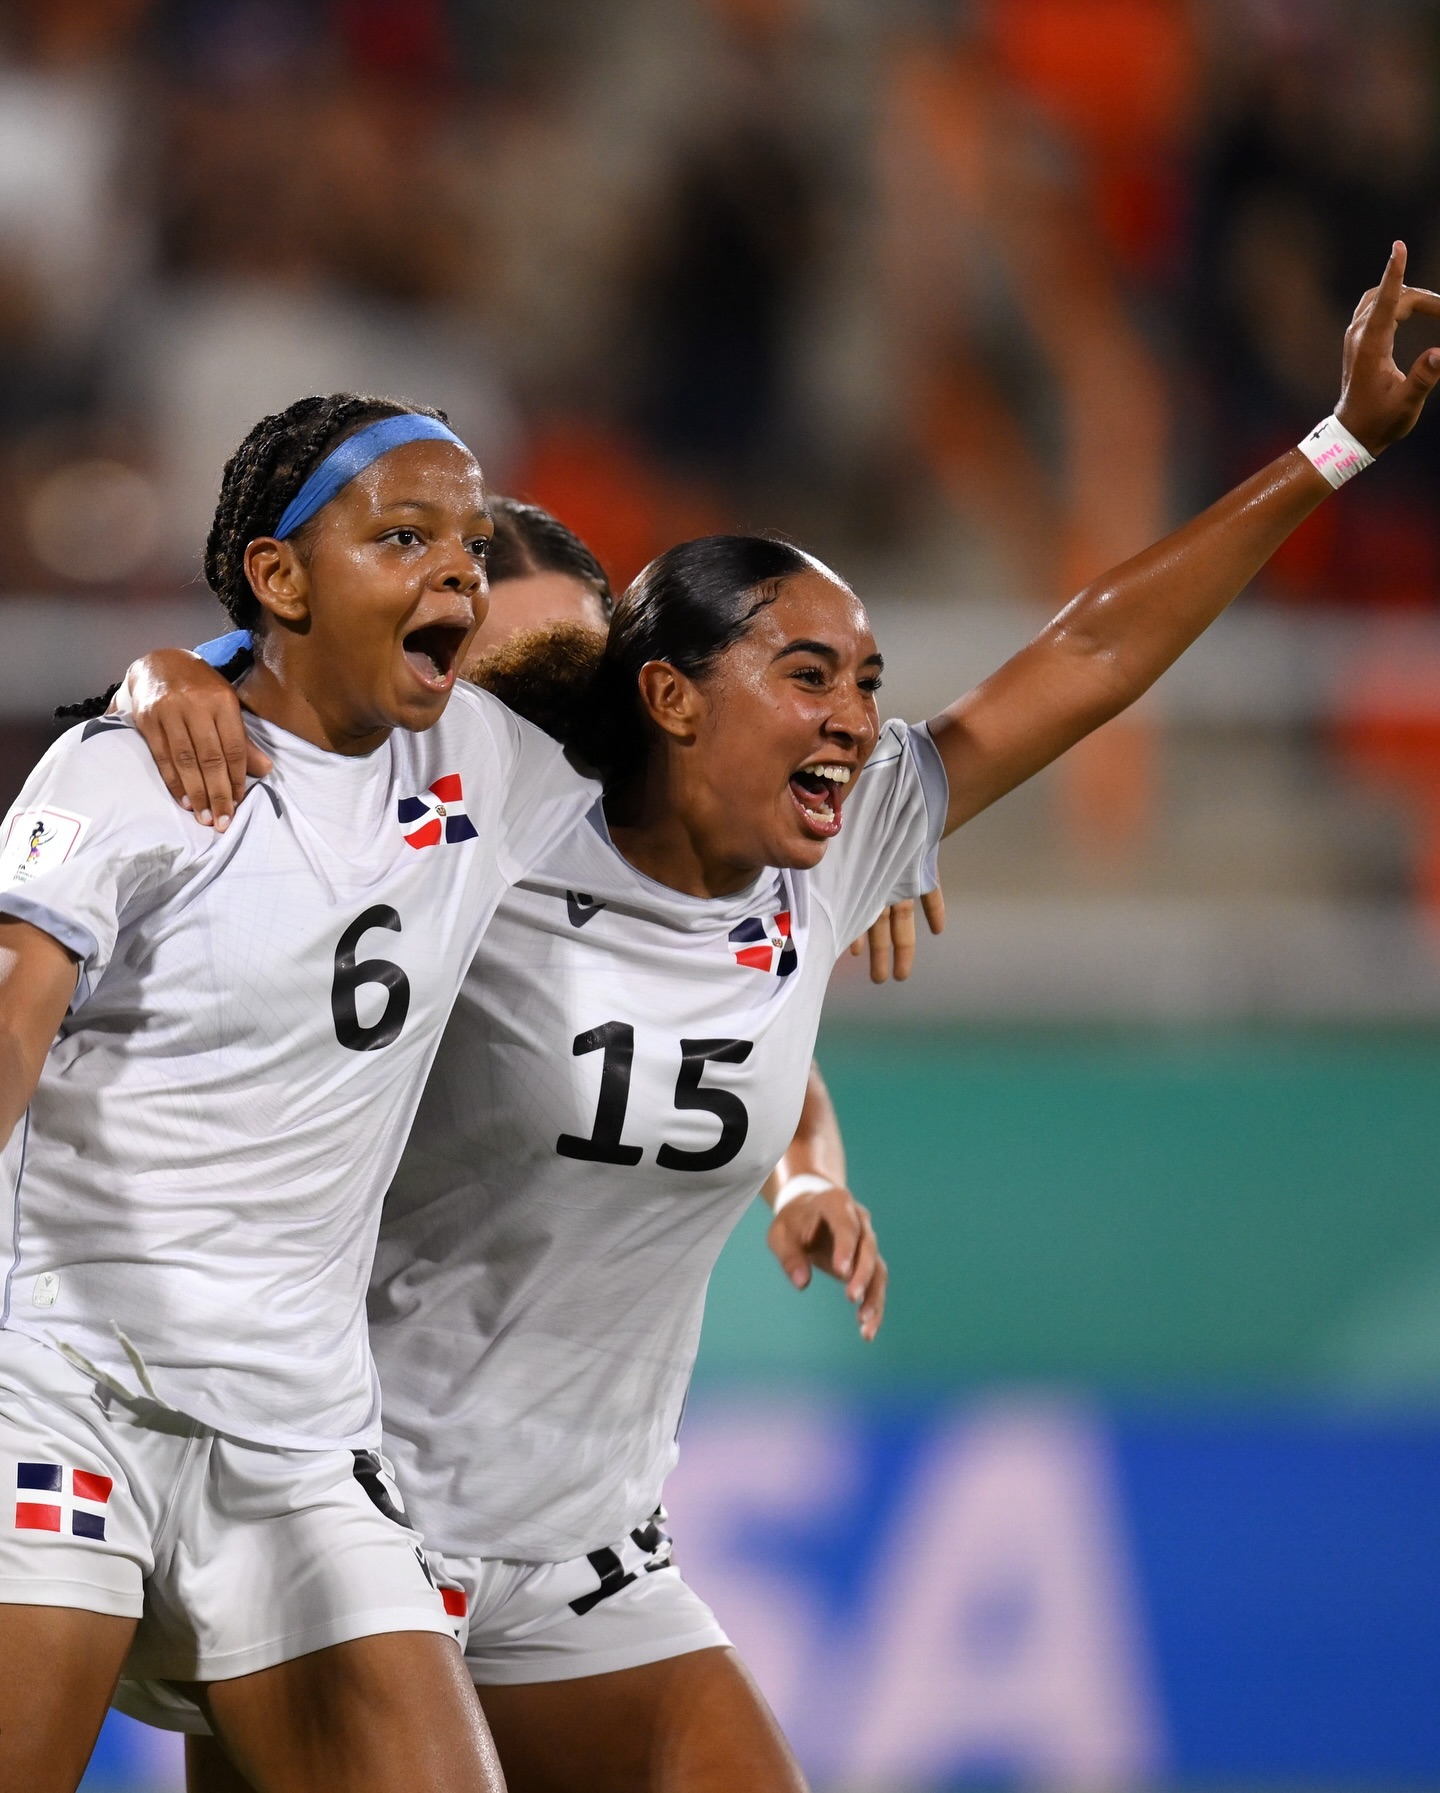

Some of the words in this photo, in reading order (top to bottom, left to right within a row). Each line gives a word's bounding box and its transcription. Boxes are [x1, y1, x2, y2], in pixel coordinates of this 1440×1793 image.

[1313, 442, 1344, 470] HAVE
[331, 904, 411, 1052] 6
[556, 1020, 754, 1172] 15
